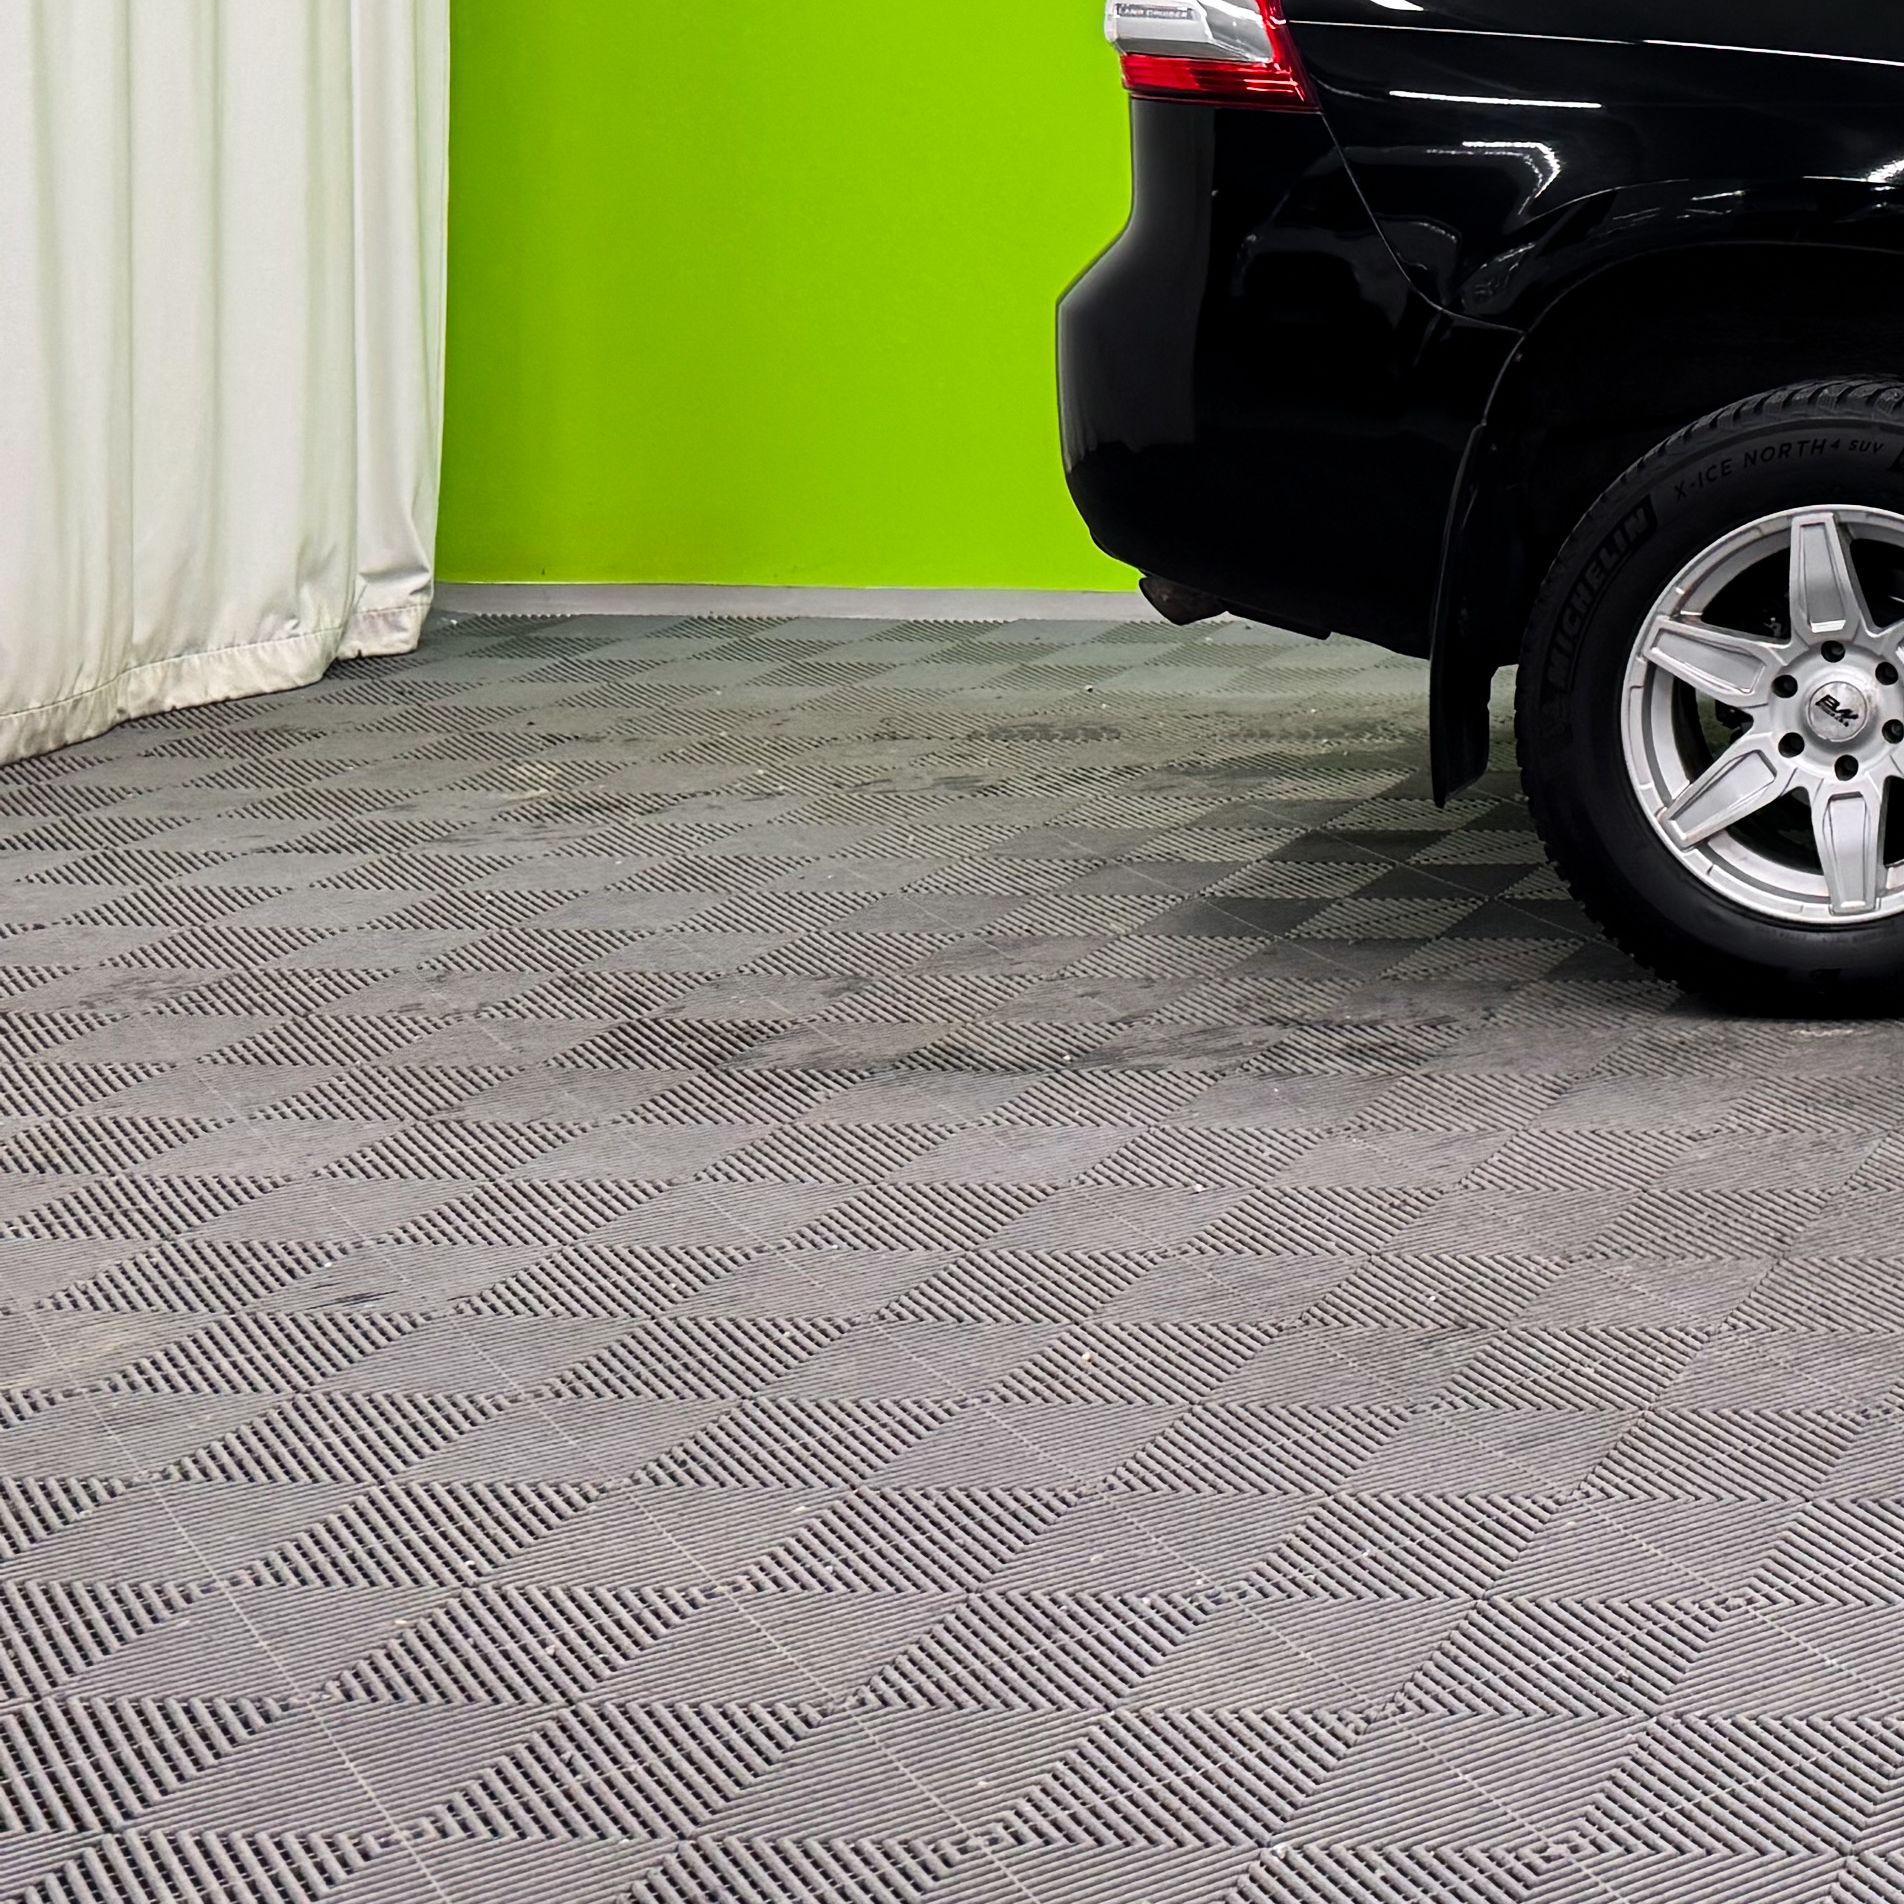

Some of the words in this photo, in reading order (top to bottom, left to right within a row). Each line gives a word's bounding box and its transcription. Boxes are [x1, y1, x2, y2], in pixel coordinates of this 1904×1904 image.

[1673, 461, 1734, 499] X-ICE
[1848, 439, 1884, 453] SUV
[1546, 503, 1650, 692] MICHELIN
